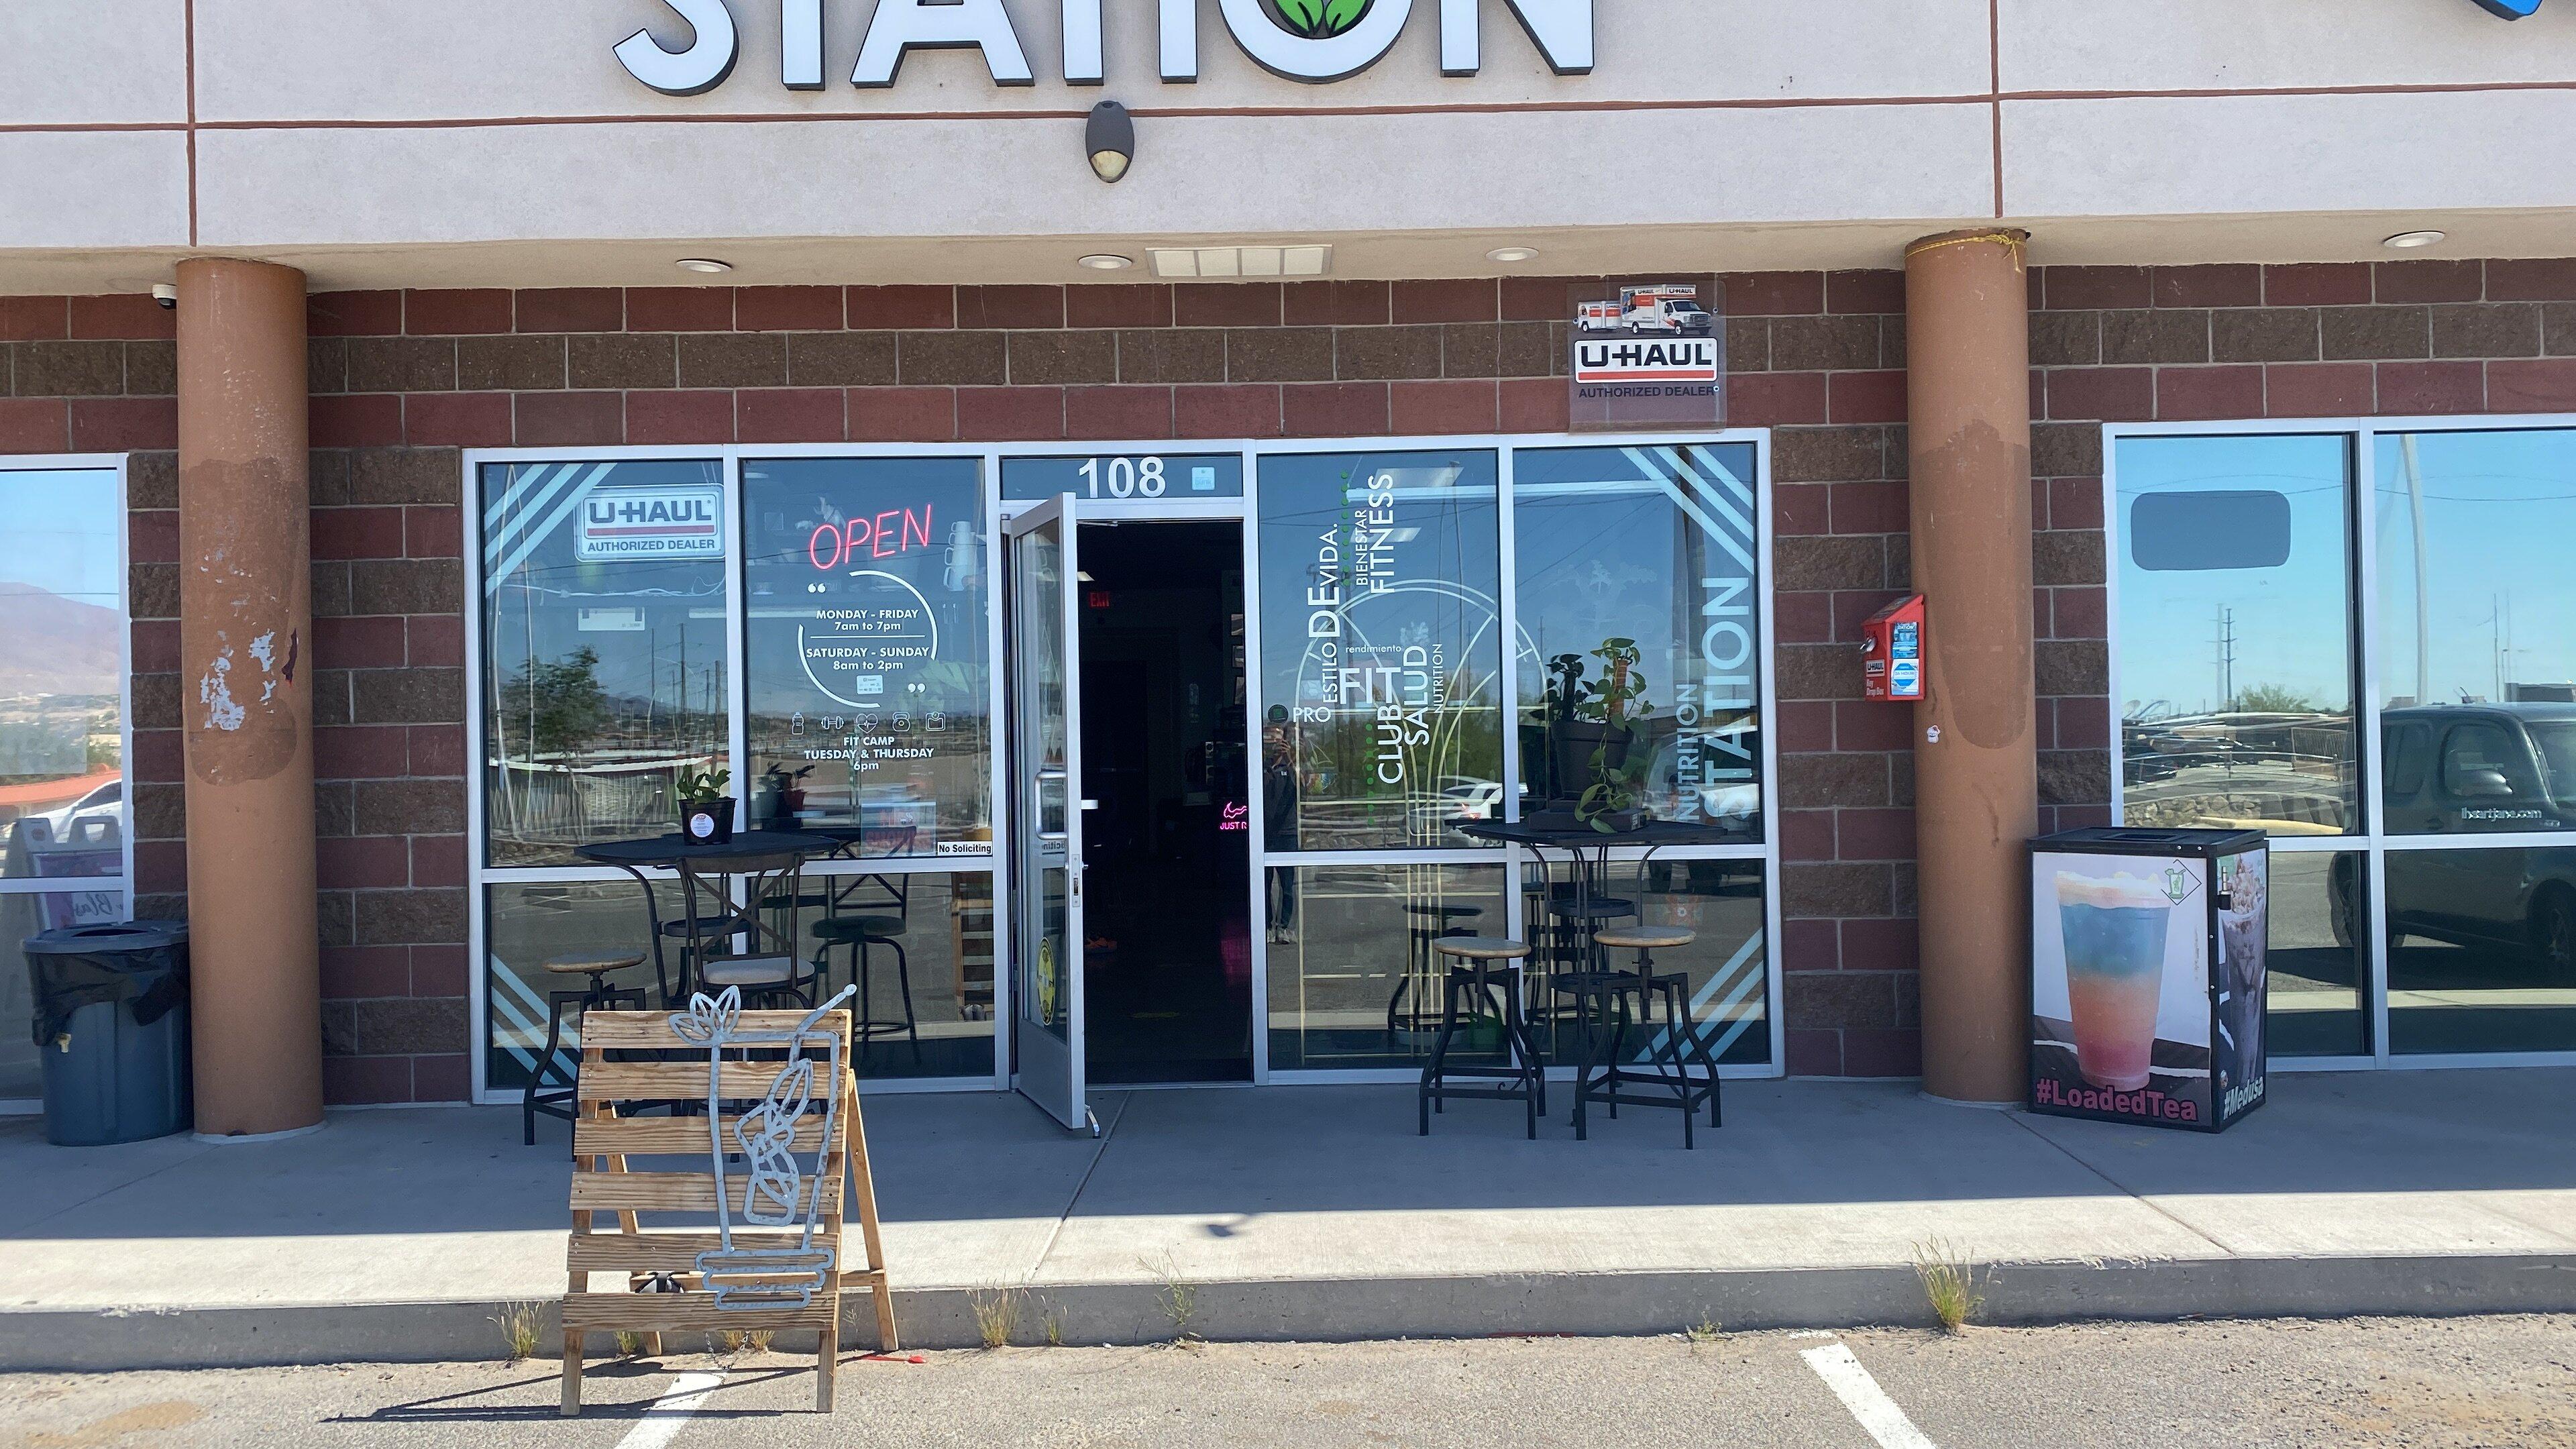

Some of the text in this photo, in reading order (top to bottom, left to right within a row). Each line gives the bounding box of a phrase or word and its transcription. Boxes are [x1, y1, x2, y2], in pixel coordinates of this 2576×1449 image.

[1581, 343, 1712, 367] U-HAUL
[1579, 386, 1715, 398] AUTHORIZED DEALER
[1079, 456, 1166, 498] 108
[590, 500, 712, 523] U-HAUL
[588, 539, 715, 551] AUTHORIZED DEALER
[809, 503, 932, 570] OPEN
[1368, 474, 1395, 593] FITNESS
[1355, 510, 1368, 586] BIENESTAR
[816, 610, 867, 620] MONDAY
[879, 609, 918, 619] FRIDAY
[835, 621, 901, 633] 7am to 7pm
[806, 647, 867, 657] SATURDAY
[880, 647, 929, 657] SUNDAY
[1345, 644, 1402, 653] rendimiento
[833, 661, 904, 672] 8am to 2pm
[1322, 642, 1338, 703] ESTILO
[1339, 667, 1401, 704] FIT
[1433, 644, 1444, 713] NUTRITION
[1403, 646, 1429, 746] SALUD
[1701, 577, 1753, 820] STATION
[1293, 706, 1332, 723] PRO
[843, 737, 895, 746] FIT CAMP
[1377, 704, 1403, 784] CLUB
[1676, 684, 1700, 821] NUTRITION
[804, 748, 934, 759] TUESDAY & THURSDAY
[853, 761, 879, 771] 6pm
[1220, 822, 1240, 830] JUST
[938, 844, 991, 855] No Soliciting
[2037, 1078, 2198, 1121] #LoadedTea
[2223, 1076, 2265, 1120] #Medusa
